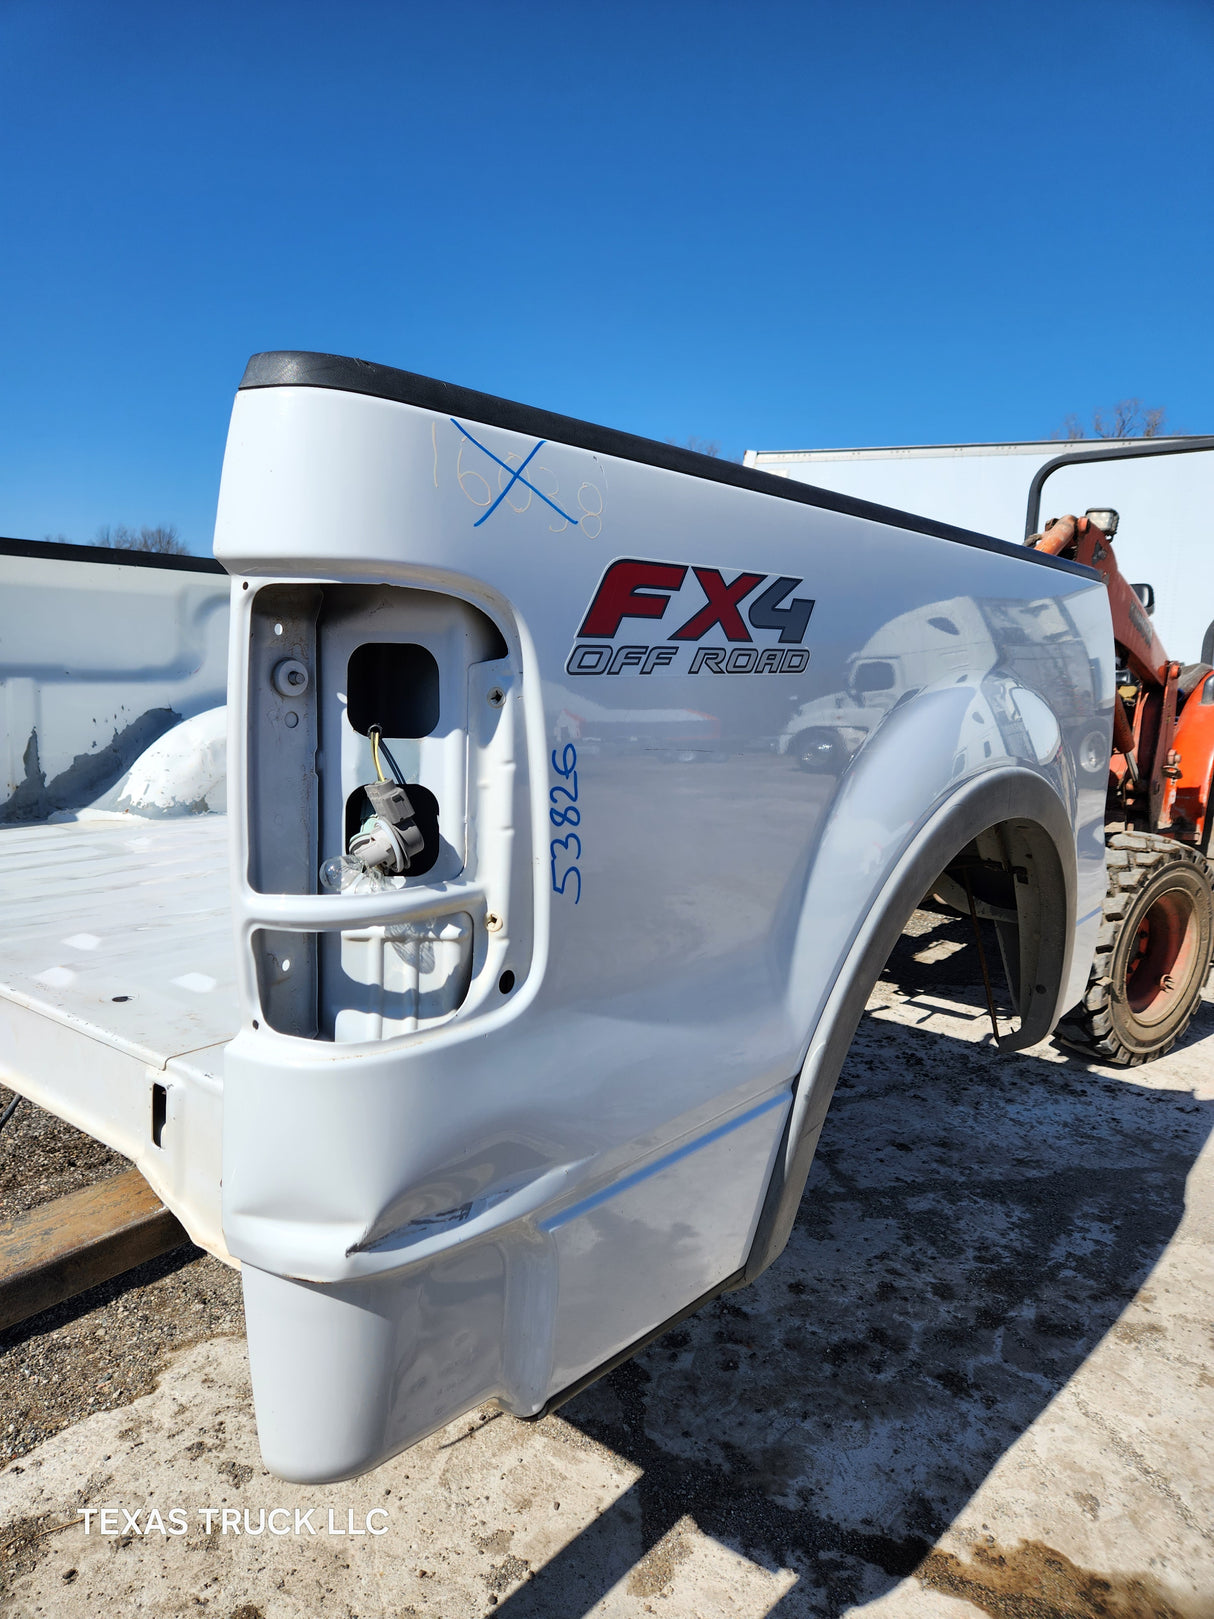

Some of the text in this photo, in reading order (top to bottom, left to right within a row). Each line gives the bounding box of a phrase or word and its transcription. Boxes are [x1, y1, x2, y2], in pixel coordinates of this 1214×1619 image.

[576, 558, 816, 644] FX4
[566, 644, 811, 676] OFF ROAD
[549, 743, 582, 905] 53826
